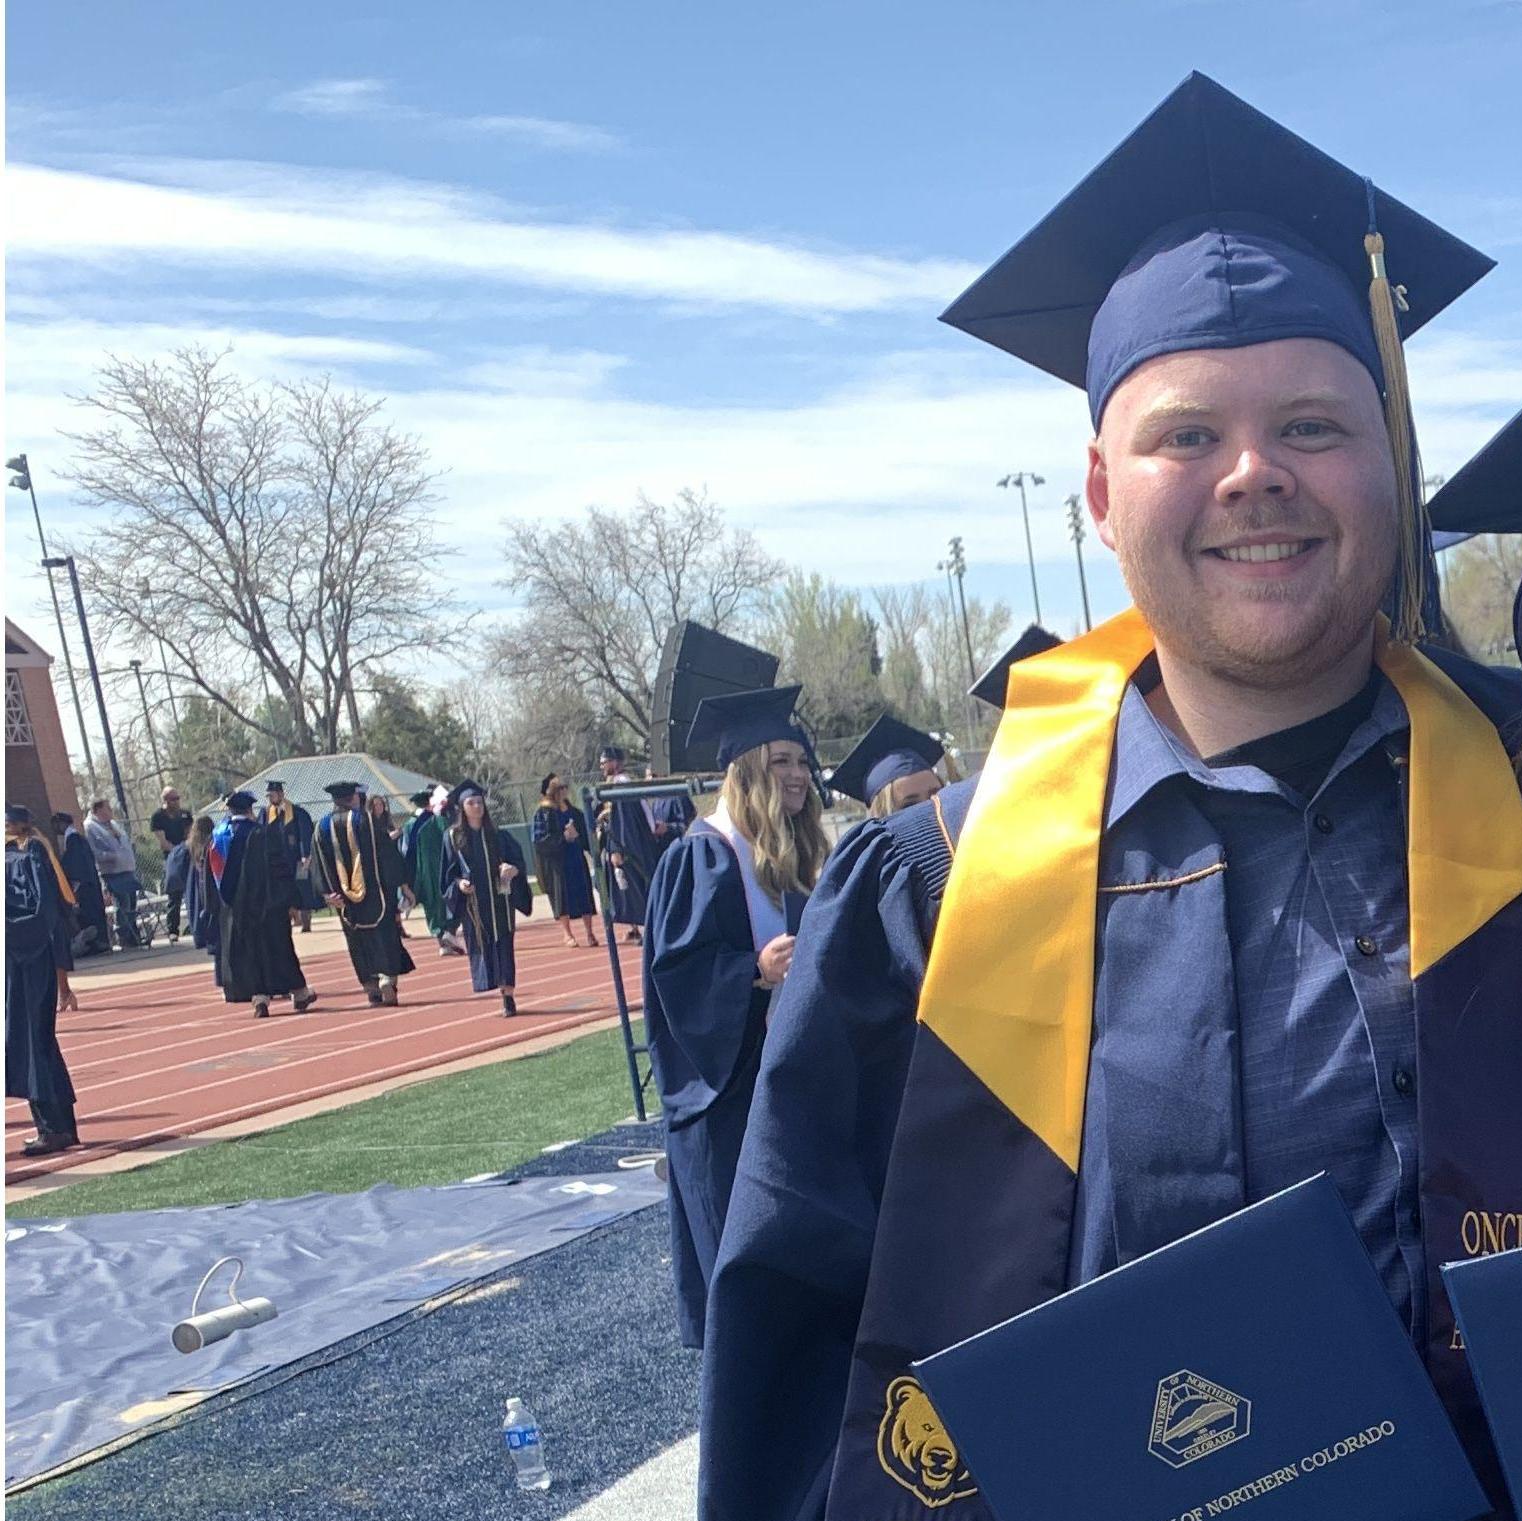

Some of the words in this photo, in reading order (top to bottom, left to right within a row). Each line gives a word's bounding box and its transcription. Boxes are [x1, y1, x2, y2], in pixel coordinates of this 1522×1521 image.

[1187, 1375, 1240, 1406] NORTHERN
[1153, 1387, 1170, 1443] UNIVERSITY
[1183, 1430, 1236, 1460] COLORADO
[1205, 1463, 1300, 1517] NORTHERN
[1300, 1420, 1395, 1473] COLORADO
